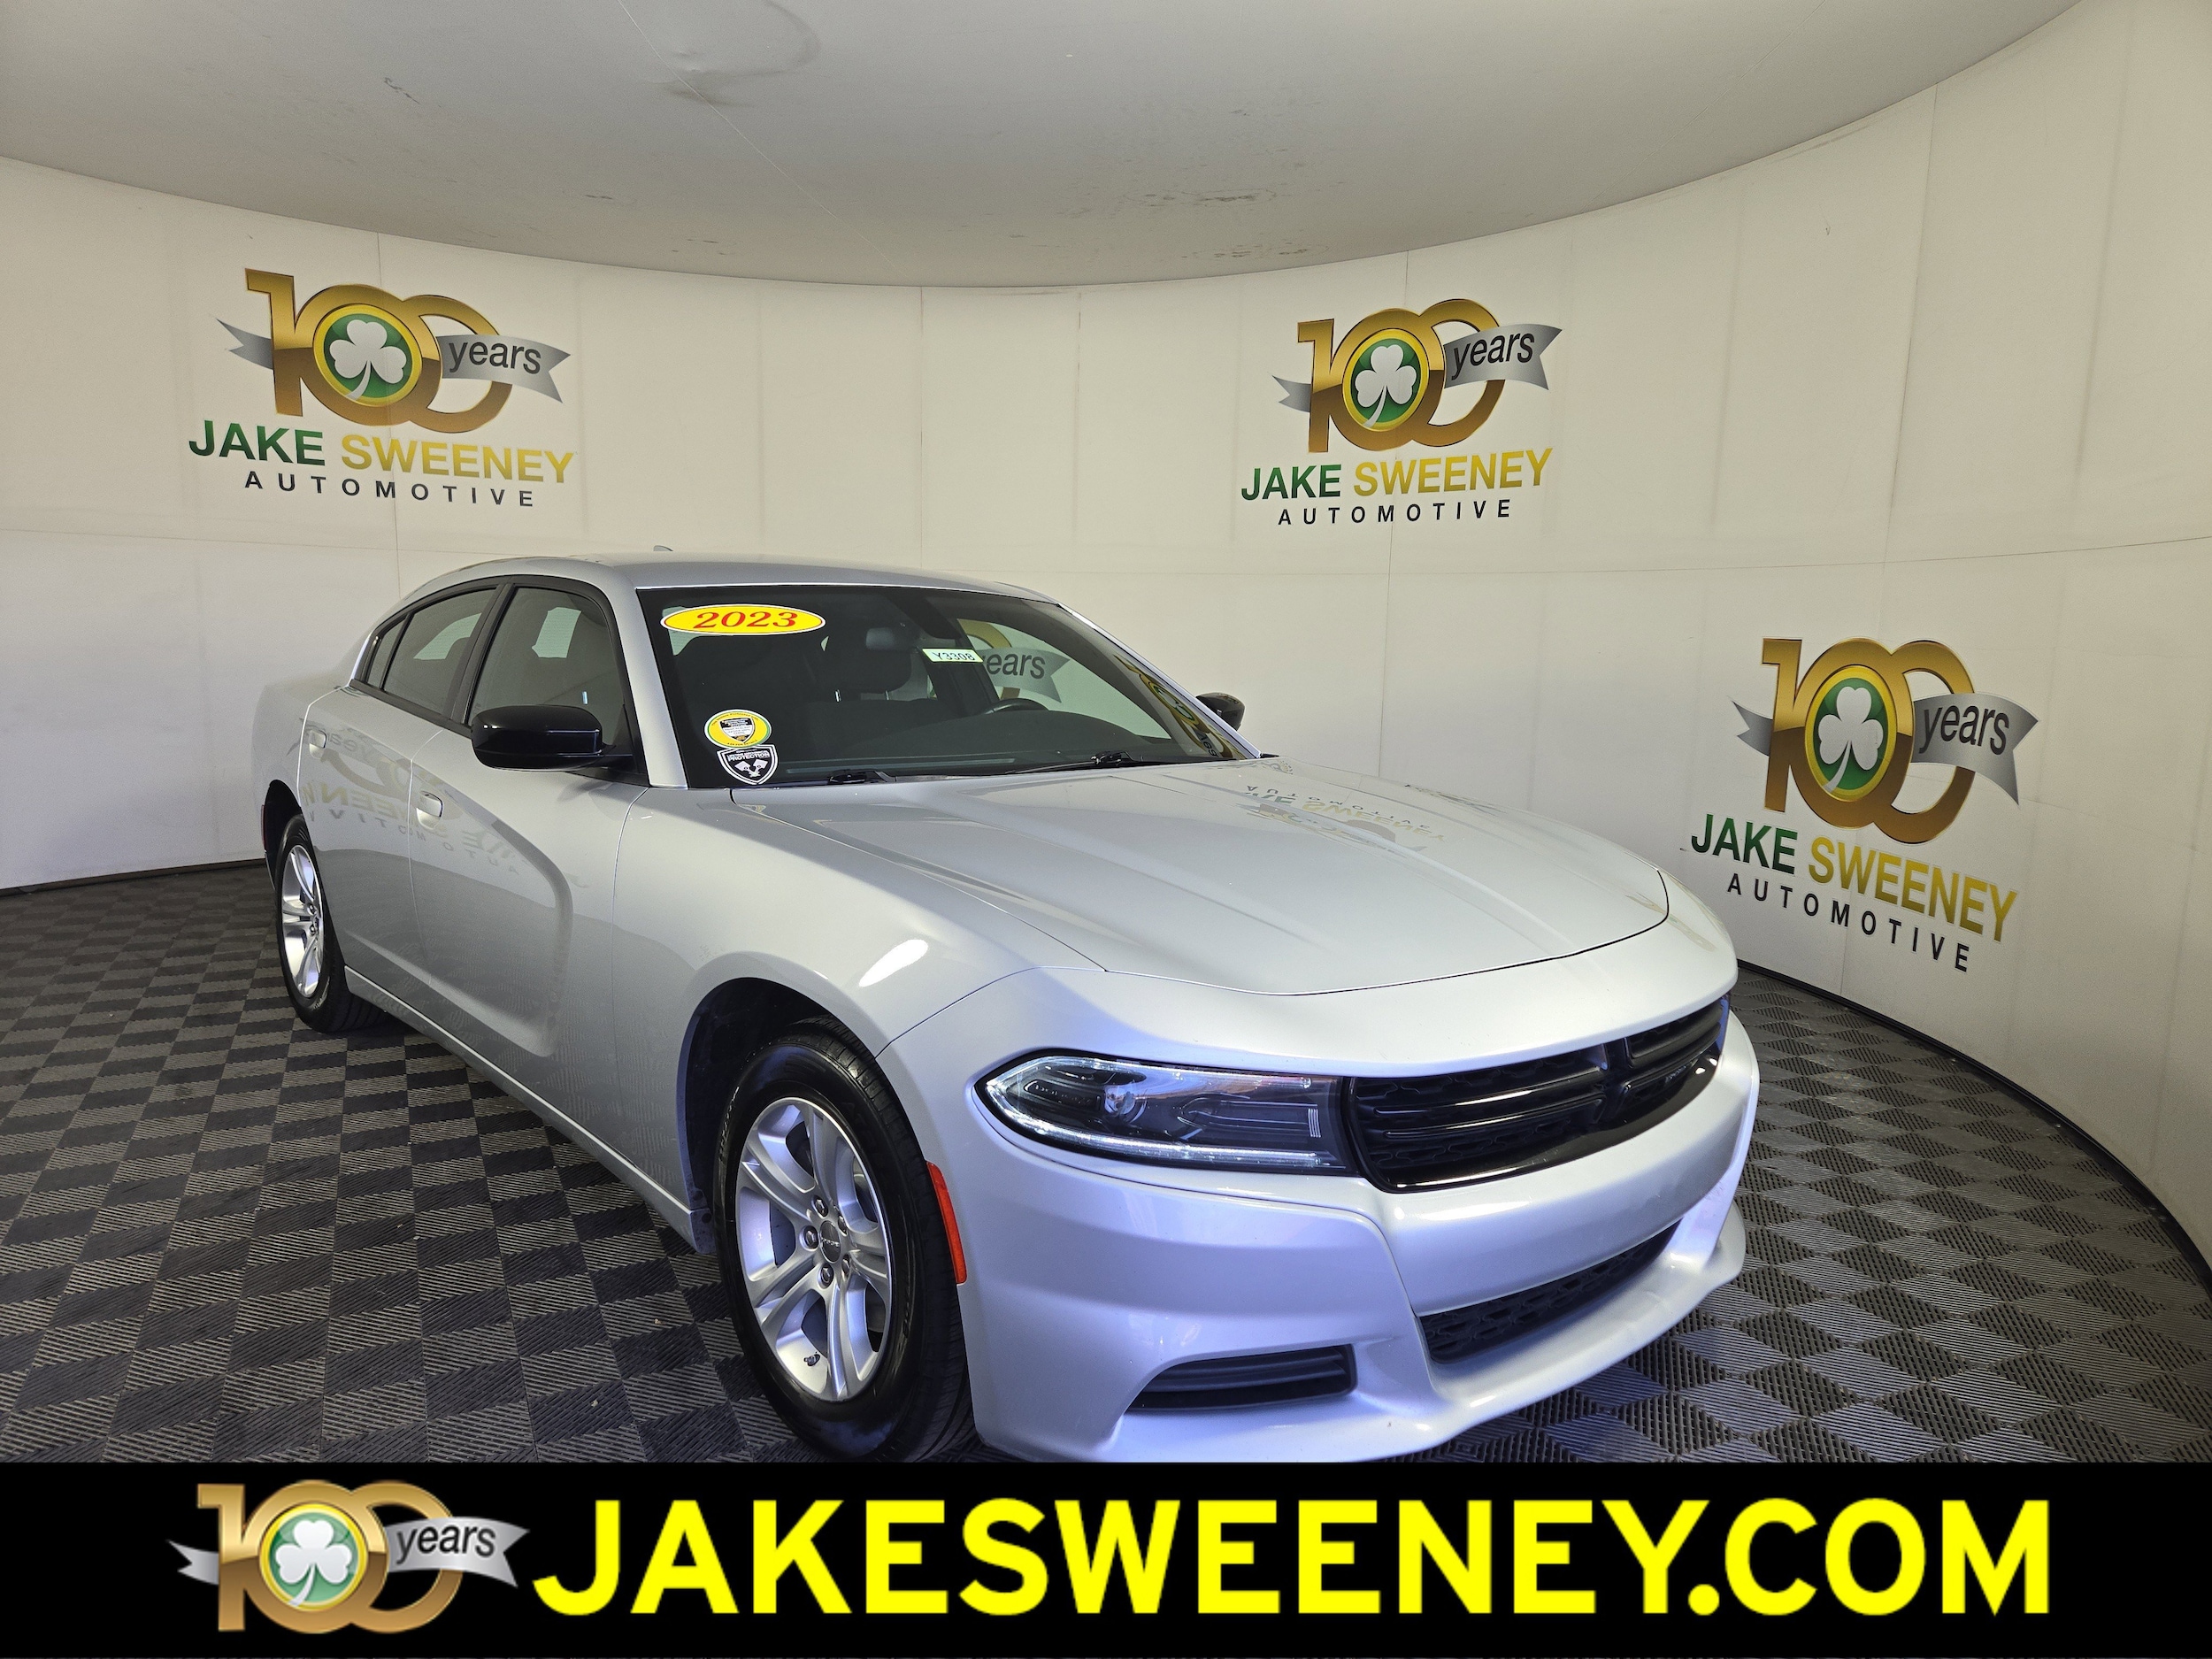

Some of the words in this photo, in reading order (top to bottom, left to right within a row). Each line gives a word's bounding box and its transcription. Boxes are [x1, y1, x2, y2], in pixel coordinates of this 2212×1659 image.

[244, 267, 512, 434] 100
[448, 341, 541, 374] years
[1297, 298, 1506, 453] 100
[1451, 332, 1535, 380] years
[188, 419, 326, 465] JAKE
[342, 434, 574, 483] SWEENEY
[1240, 464, 1342, 501] JAKE
[1354, 448, 1553, 496] SWEENEY
[244, 471, 534, 506] AUTOMOTIVE
[1279, 499, 1510, 525] AUTOMOTIVE
[693, 611, 798, 629] 2023
[932, 652, 976, 661] Y3308
[983, 652, 1046, 680] ears
[1761, 637, 1976, 844] 100
[1918, 704, 2009, 756] years
[1691, 814, 1798, 874] JAKE
[1808, 836, 2017, 942] SWEENEY
[1727, 873, 1970, 972] AUTOMOTIVE
